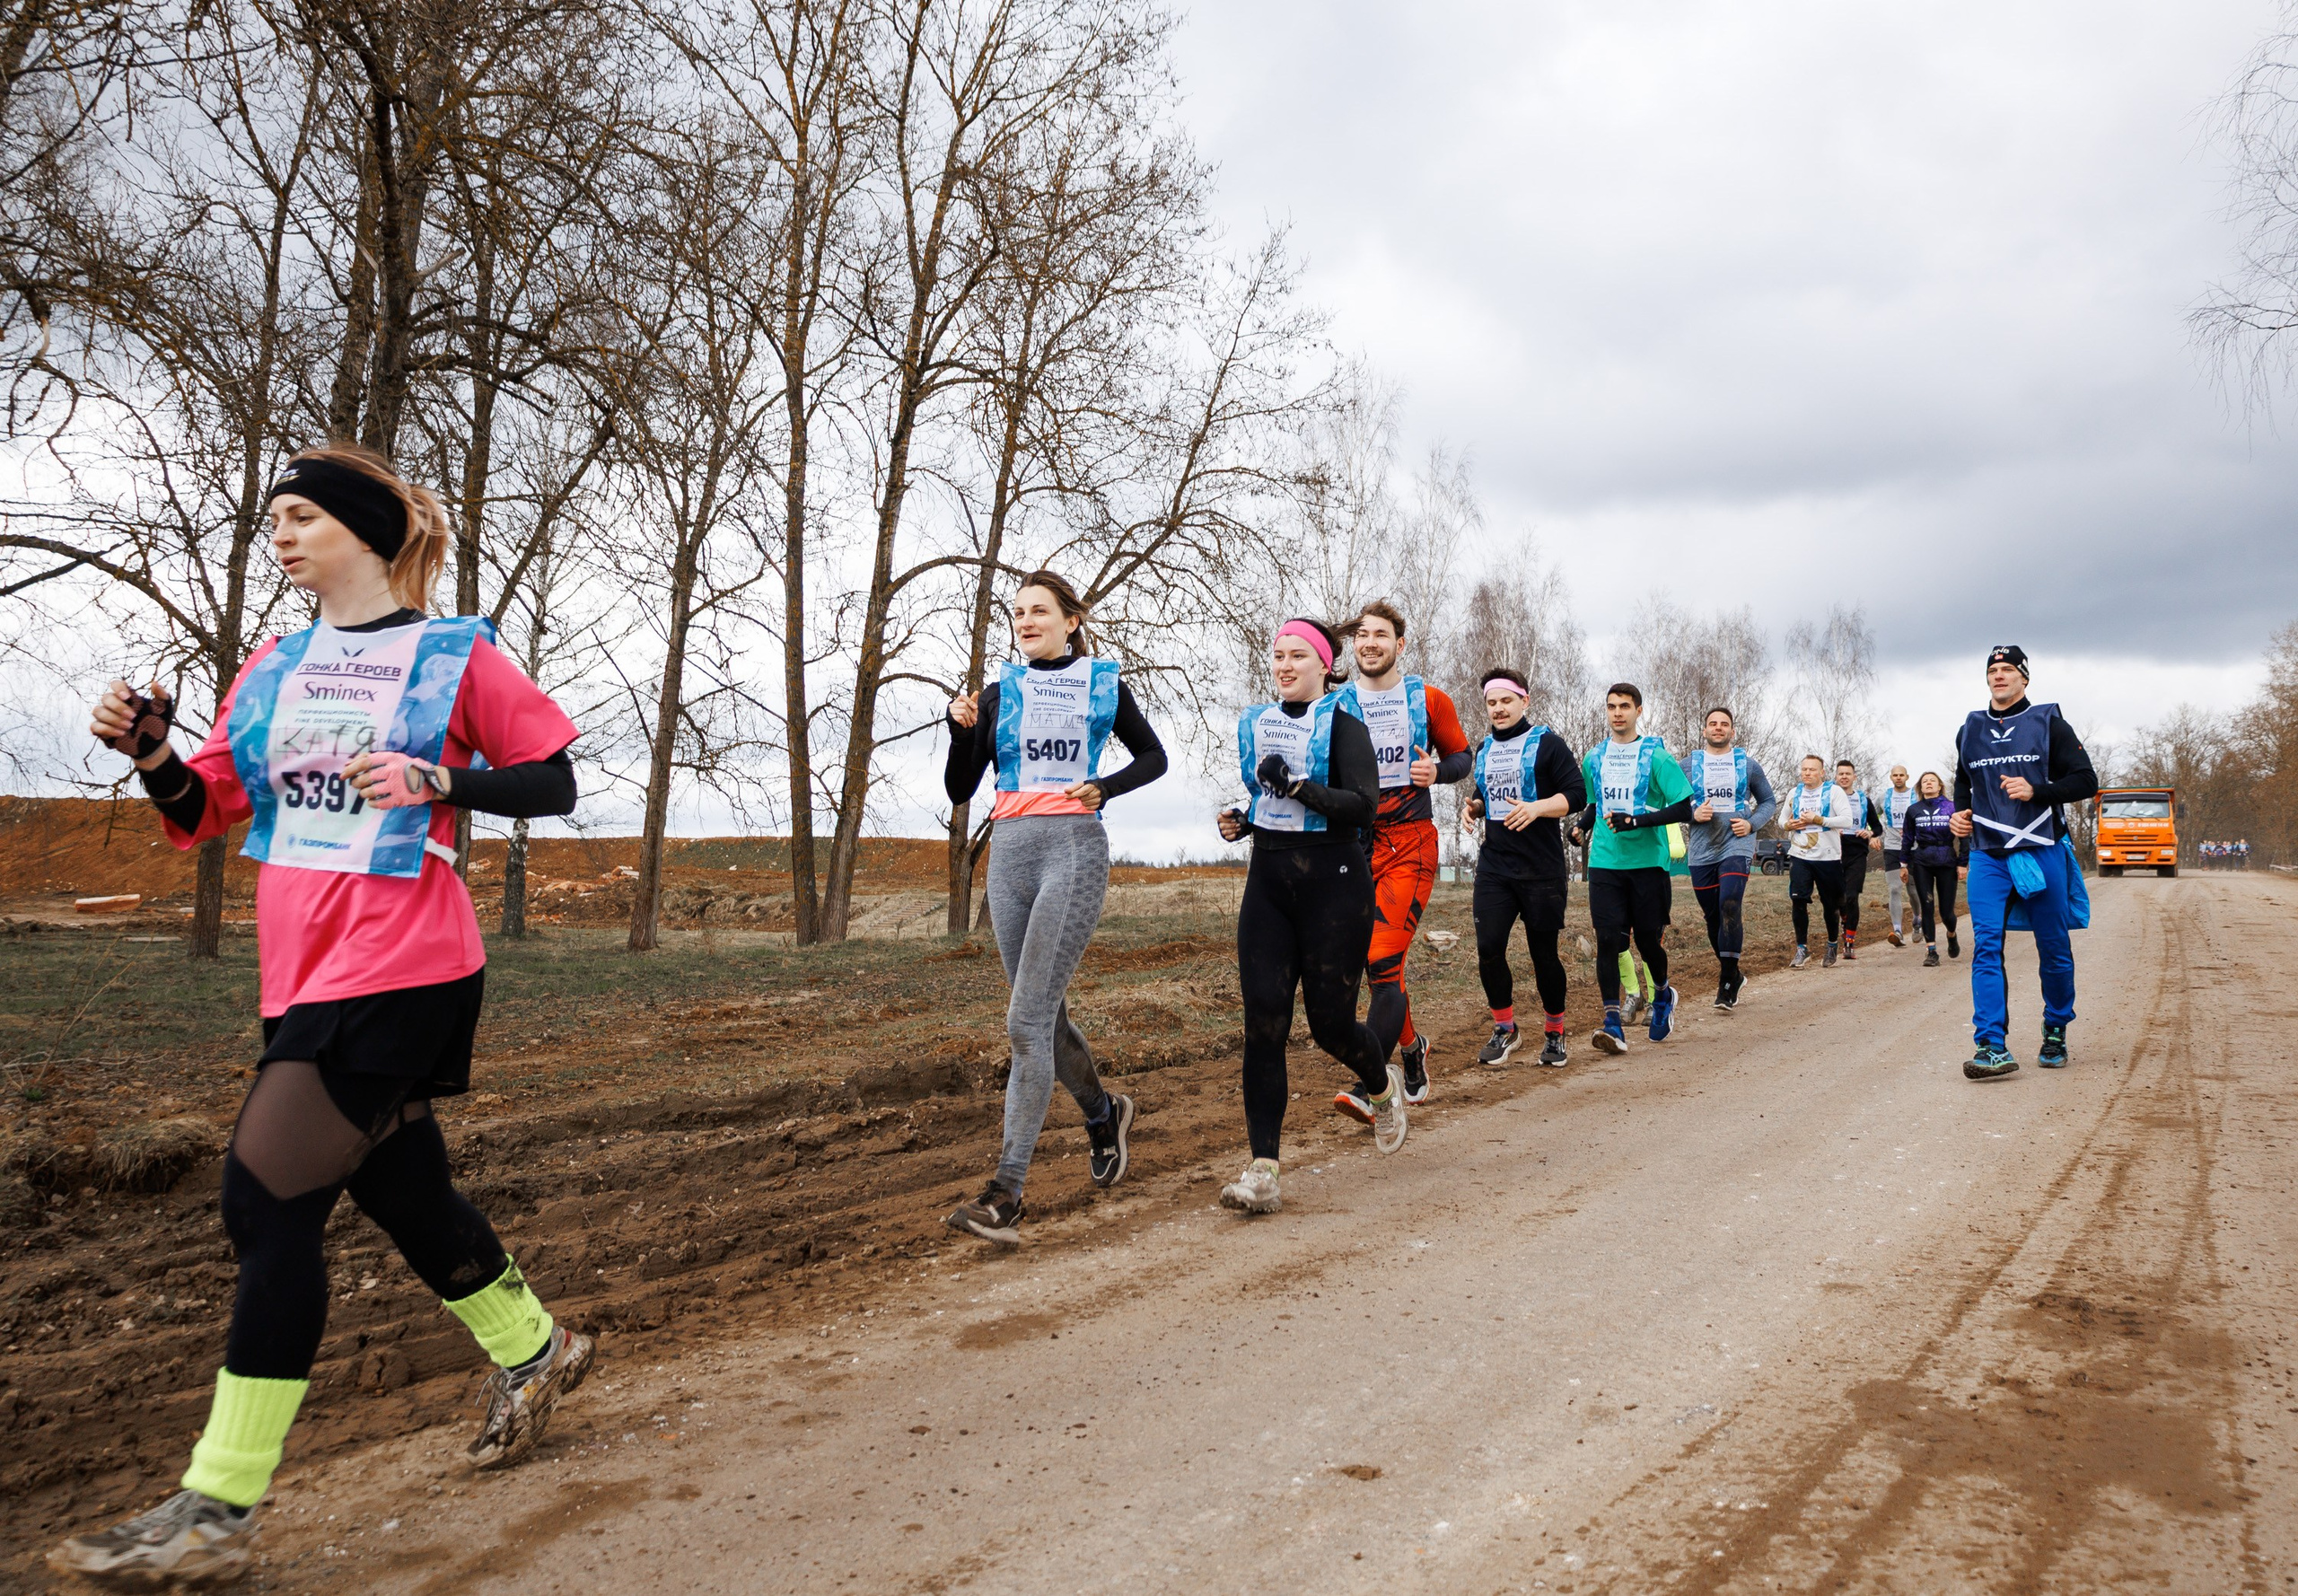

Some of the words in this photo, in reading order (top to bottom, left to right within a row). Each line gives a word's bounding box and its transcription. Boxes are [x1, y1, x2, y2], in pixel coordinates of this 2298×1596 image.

[297, 662, 341, 672] ГОНКА
[345, 662, 402, 677] ГЕРОЕВ
[303, 680, 378, 702] Sminex
[1033, 686, 1076, 701] Sminex
[297, 708, 372, 717] ПЕРФЕКЦИОНИСТЫ
[1366, 709, 1399, 718] Sminex
[312, 717, 369, 725] DEVELOPMENT
[1030, 713, 1085, 729] МАША
[1283, 721, 1311, 732] ГЕРОЕВ
[1263, 728, 1298, 741] Sminex
[1027, 739, 1081, 762] 5407
[1376, 746, 1405, 764] 402
[1969, 754, 2040, 769] ИНСТРУКТОР
[1490, 787, 1517, 802] 5404
[1604, 787, 1629, 800] 5411
[1707, 788, 1732, 798] 5406
[299, 838, 352, 850] ГАЗПРОМБАНК
